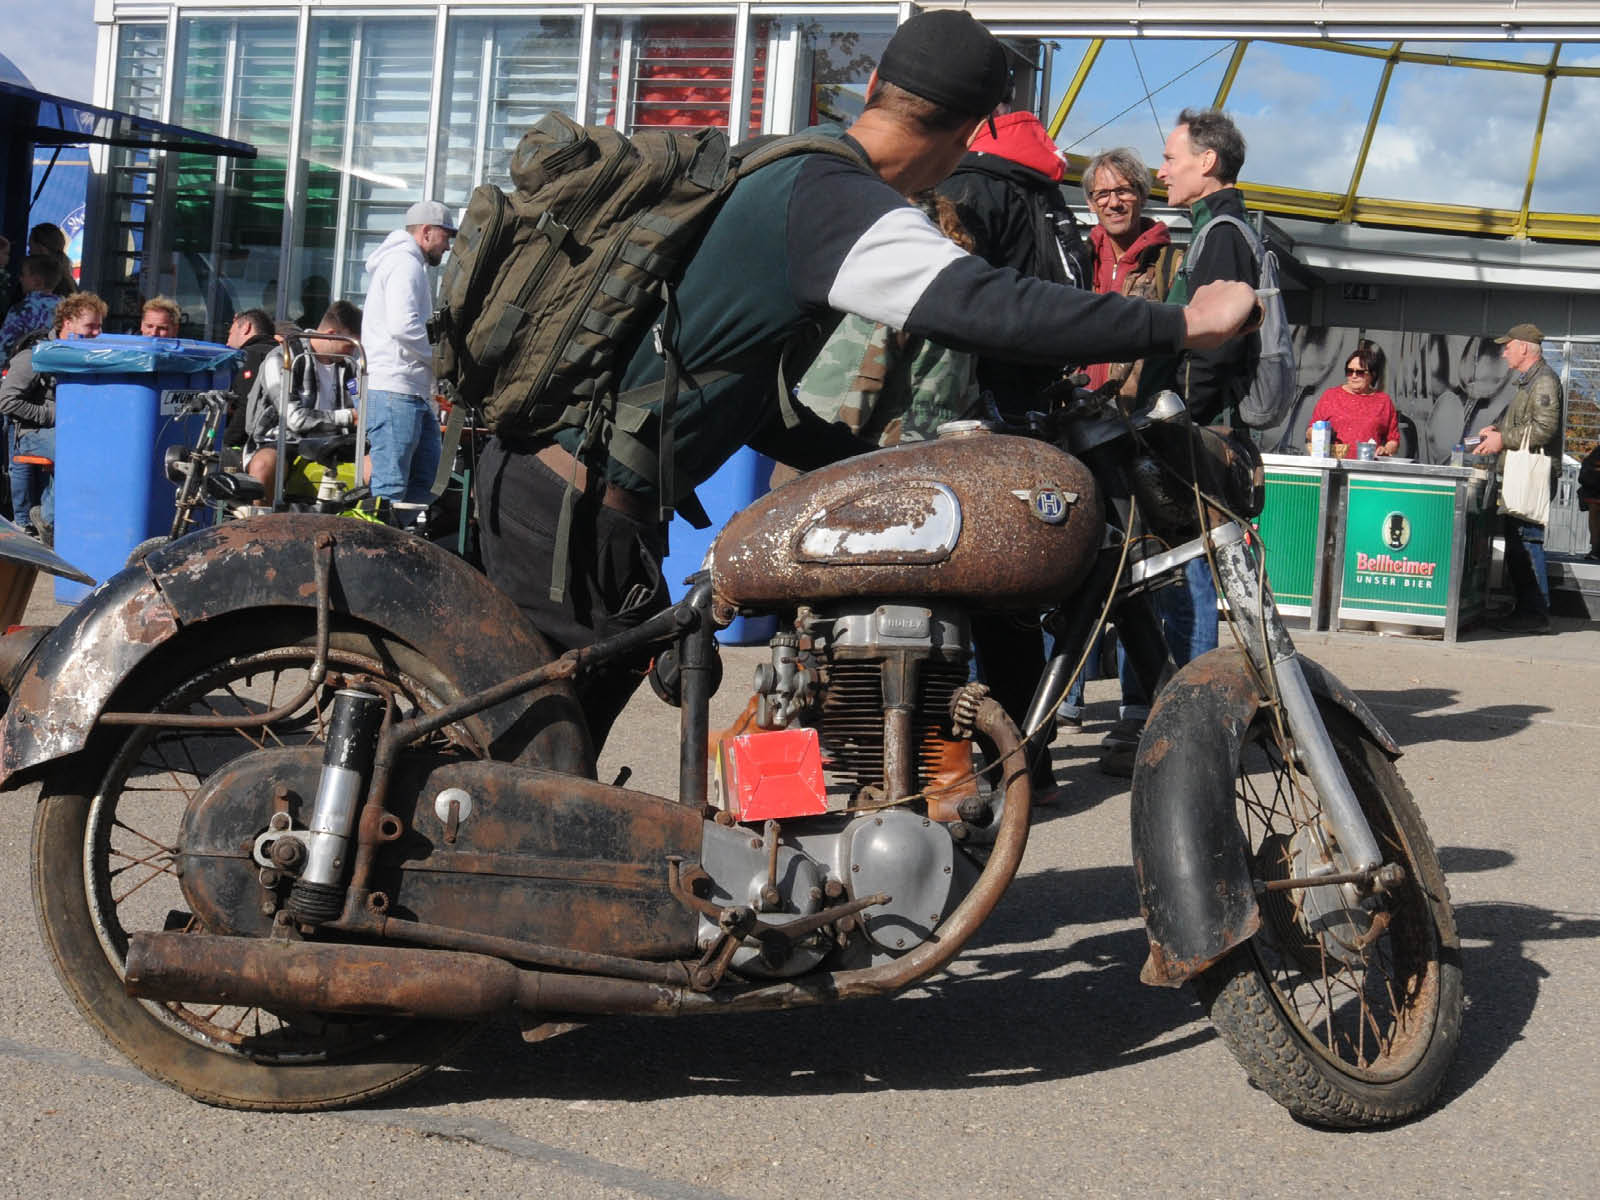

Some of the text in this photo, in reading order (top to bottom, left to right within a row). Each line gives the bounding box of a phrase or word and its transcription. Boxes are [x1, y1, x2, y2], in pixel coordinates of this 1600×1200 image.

[1041, 494, 1058, 514] H
[1356, 552, 1436, 576] Bellheimer
[1356, 575, 1432, 589] UNSER BIER
